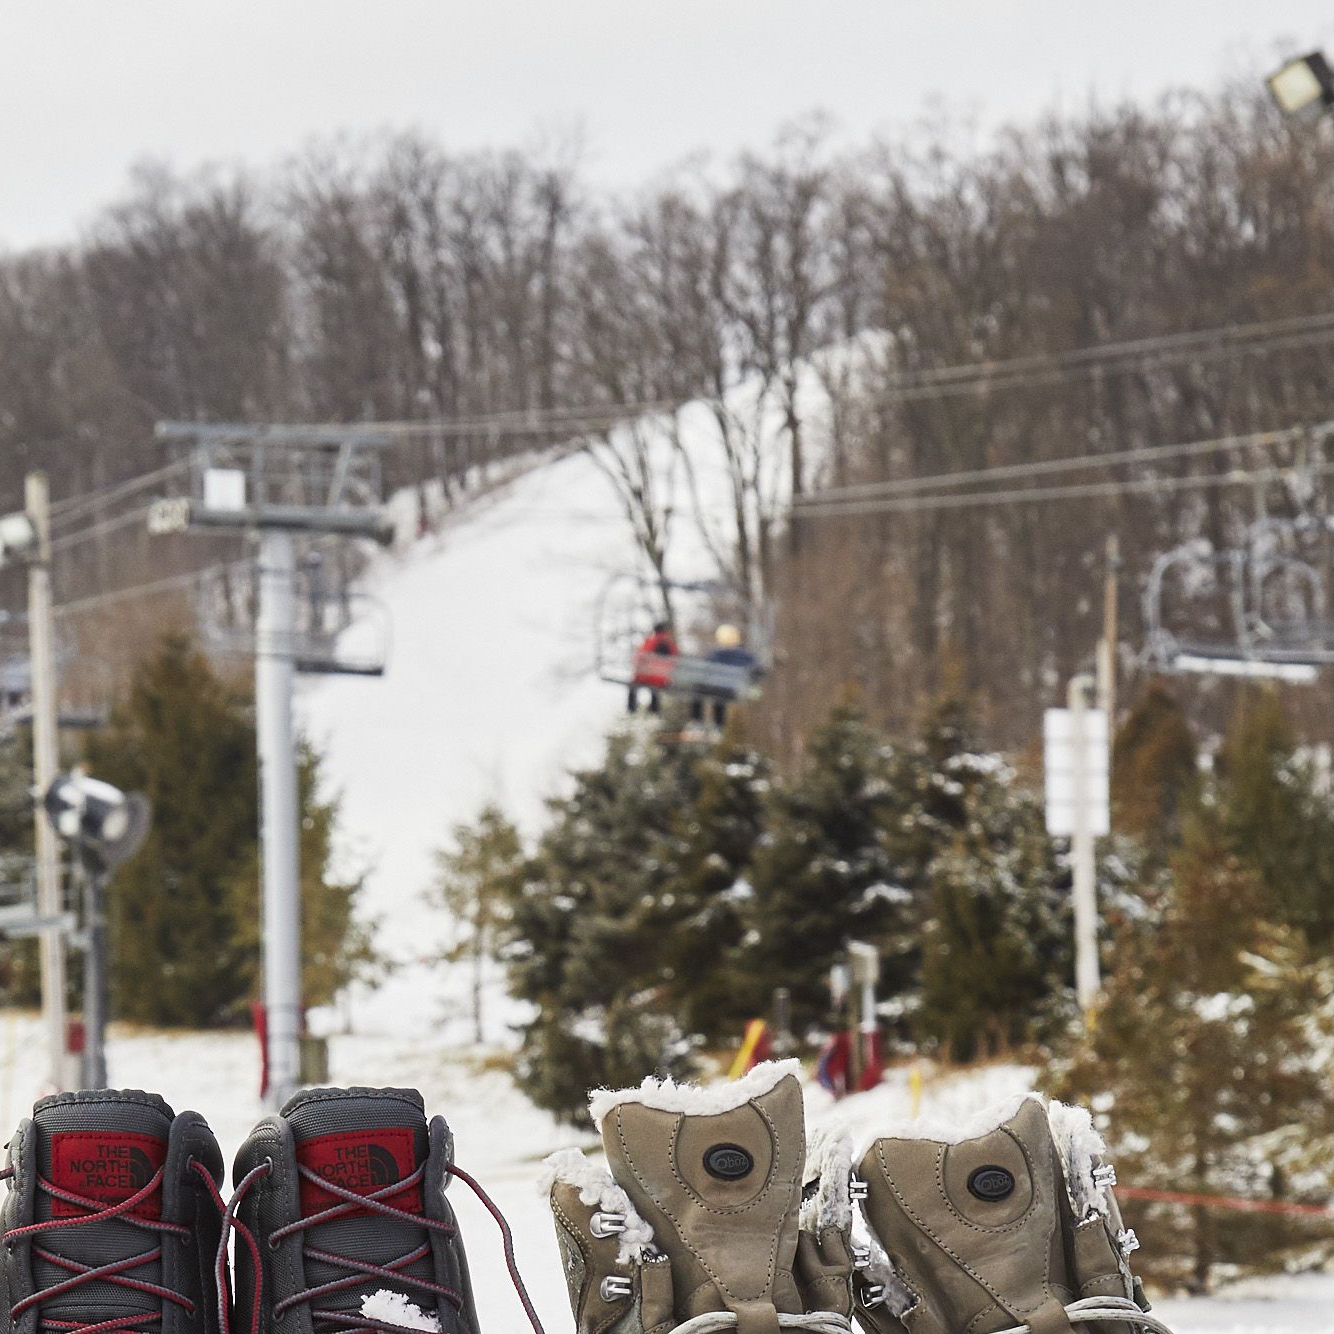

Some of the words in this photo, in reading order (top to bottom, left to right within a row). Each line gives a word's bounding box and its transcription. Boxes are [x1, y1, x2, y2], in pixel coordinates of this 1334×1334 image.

[97, 1145, 127, 1158] THE
[336, 1144, 367, 1159] THE
[70, 1160, 128, 1173] NORTH
[88, 1175, 128, 1188] FACE
